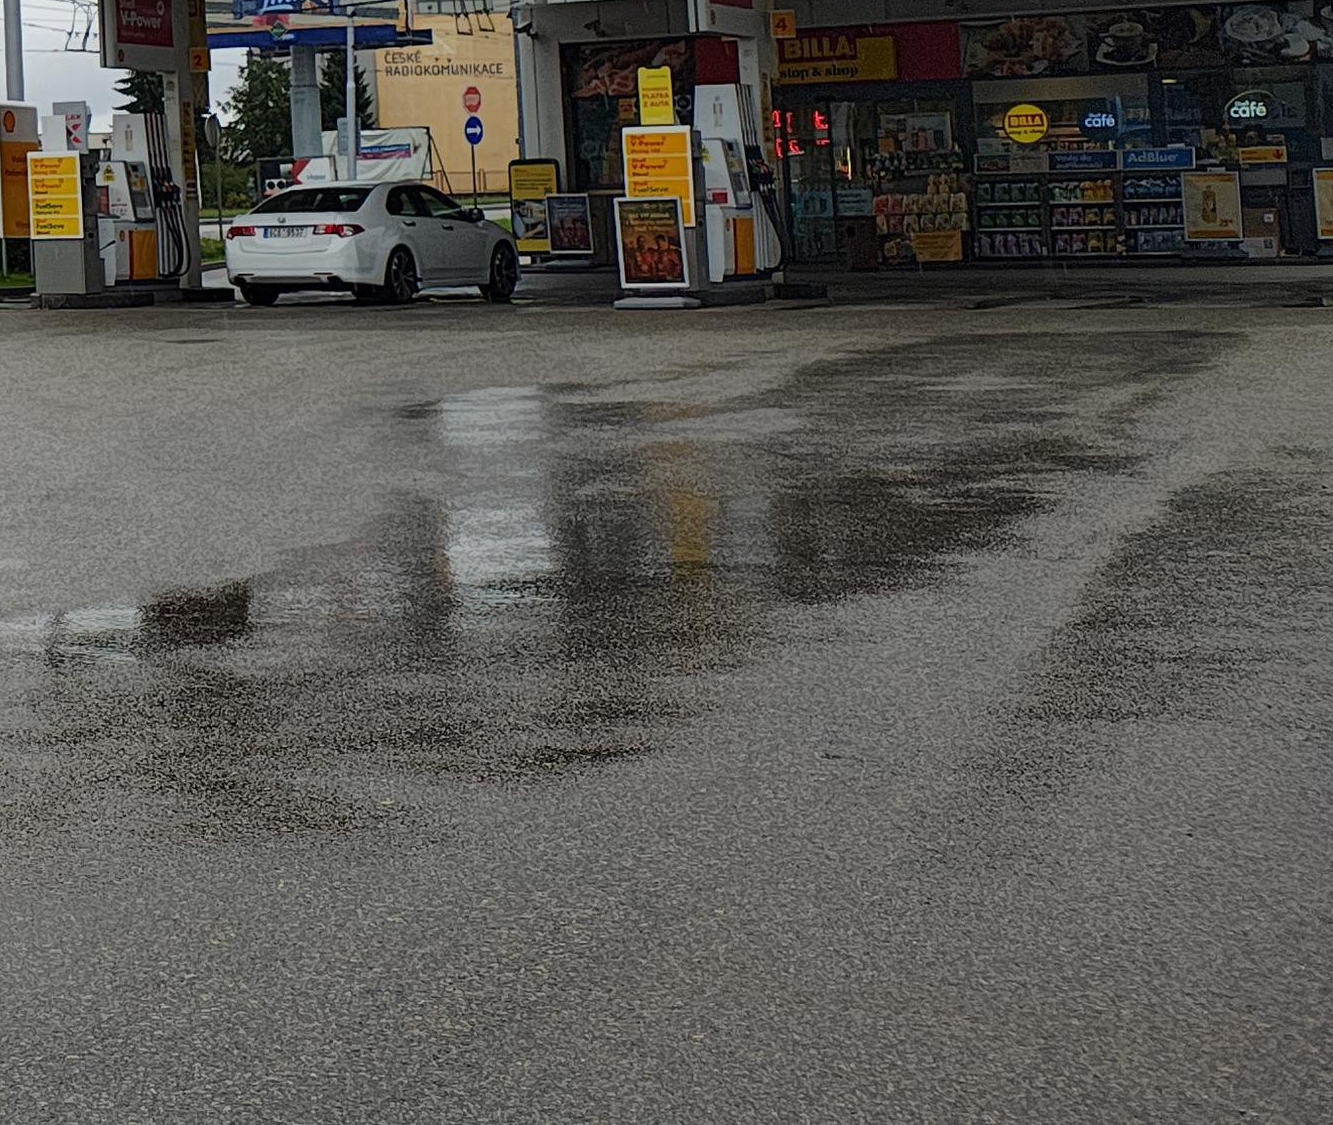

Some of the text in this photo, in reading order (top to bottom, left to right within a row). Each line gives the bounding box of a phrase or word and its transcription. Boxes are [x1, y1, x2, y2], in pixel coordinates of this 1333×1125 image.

[120, 10, 163, 29] V-Power
[776, 17, 787, 31] 4
[784, 36, 855, 59] BILLA
[194, 54, 202, 66] 2
[384, 48, 422, 64] ČESKÉ
[385, 61, 504, 76] RADIOKOMUNIKACE
[825, 62, 859, 77] shop
[1230, 102, 1267, 118] café
[1009, 116, 1042, 126] BILLA
[1084, 113, 1115, 128] café
[1128, 151, 1174, 163] AdBlue
